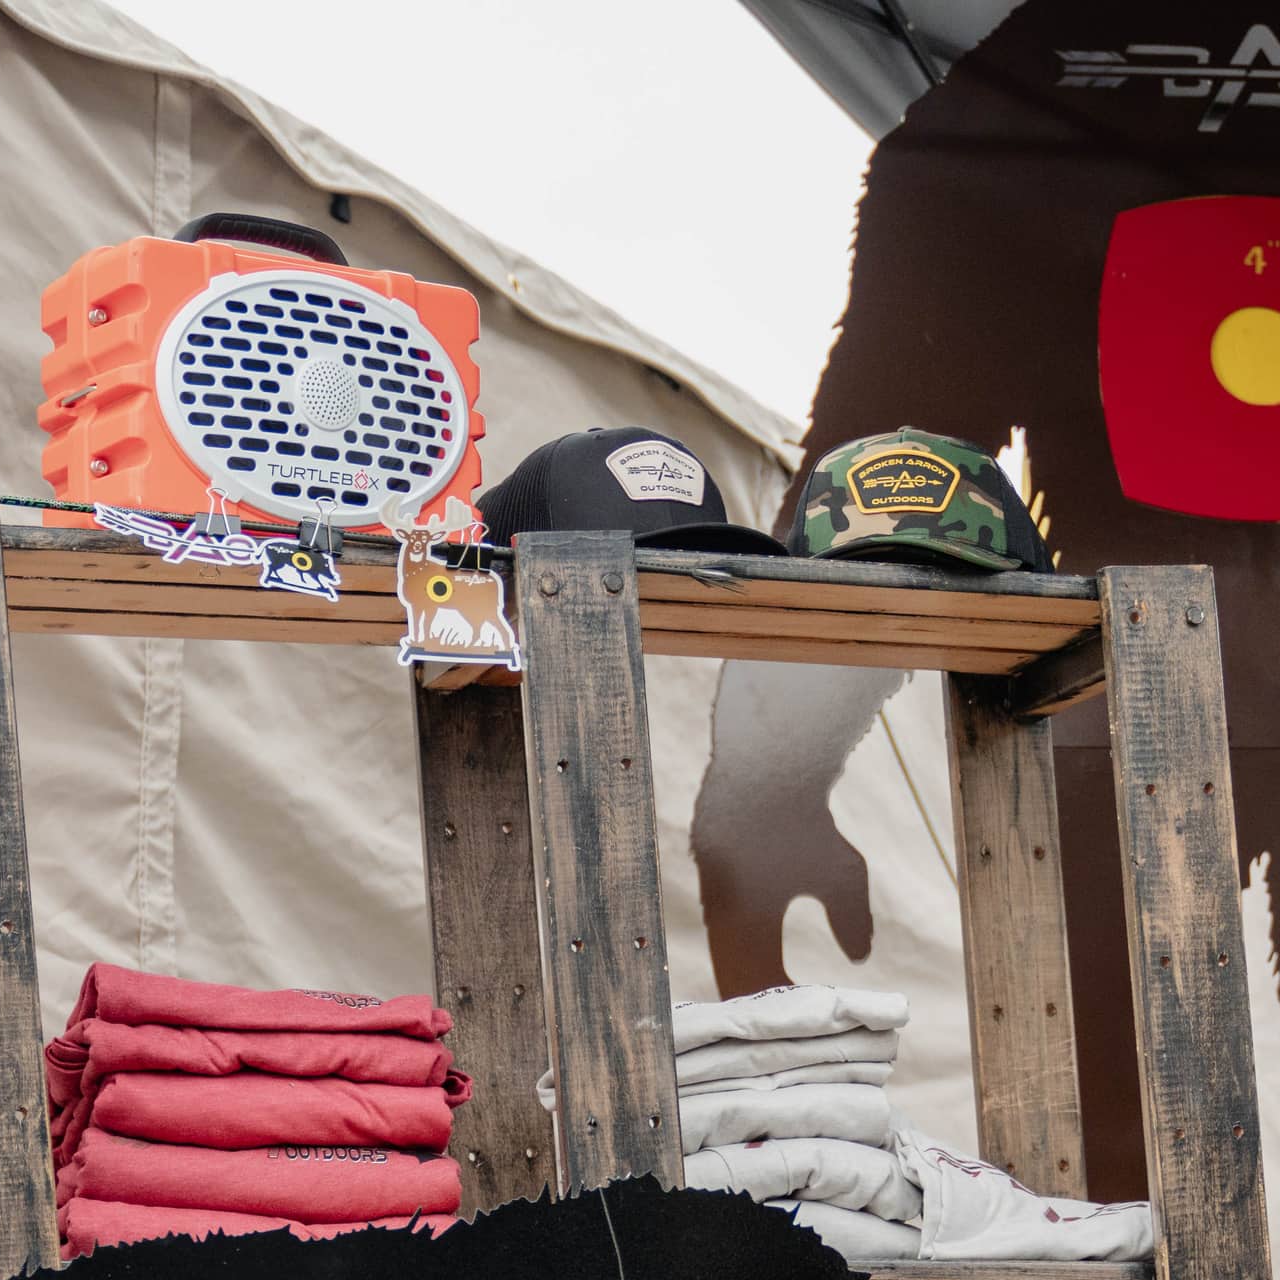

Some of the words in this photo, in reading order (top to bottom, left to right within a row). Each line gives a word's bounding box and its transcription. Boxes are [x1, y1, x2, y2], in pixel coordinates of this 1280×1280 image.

[1243, 239, 1280, 275] 4"
[620, 450, 660, 465] BROKEN
[858, 459, 903, 479] BROKEN
[905, 459, 949, 478] ARROW
[640, 485, 693, 497] OUTDOORS
[871, 495, 934, 505] OUTDOORS
